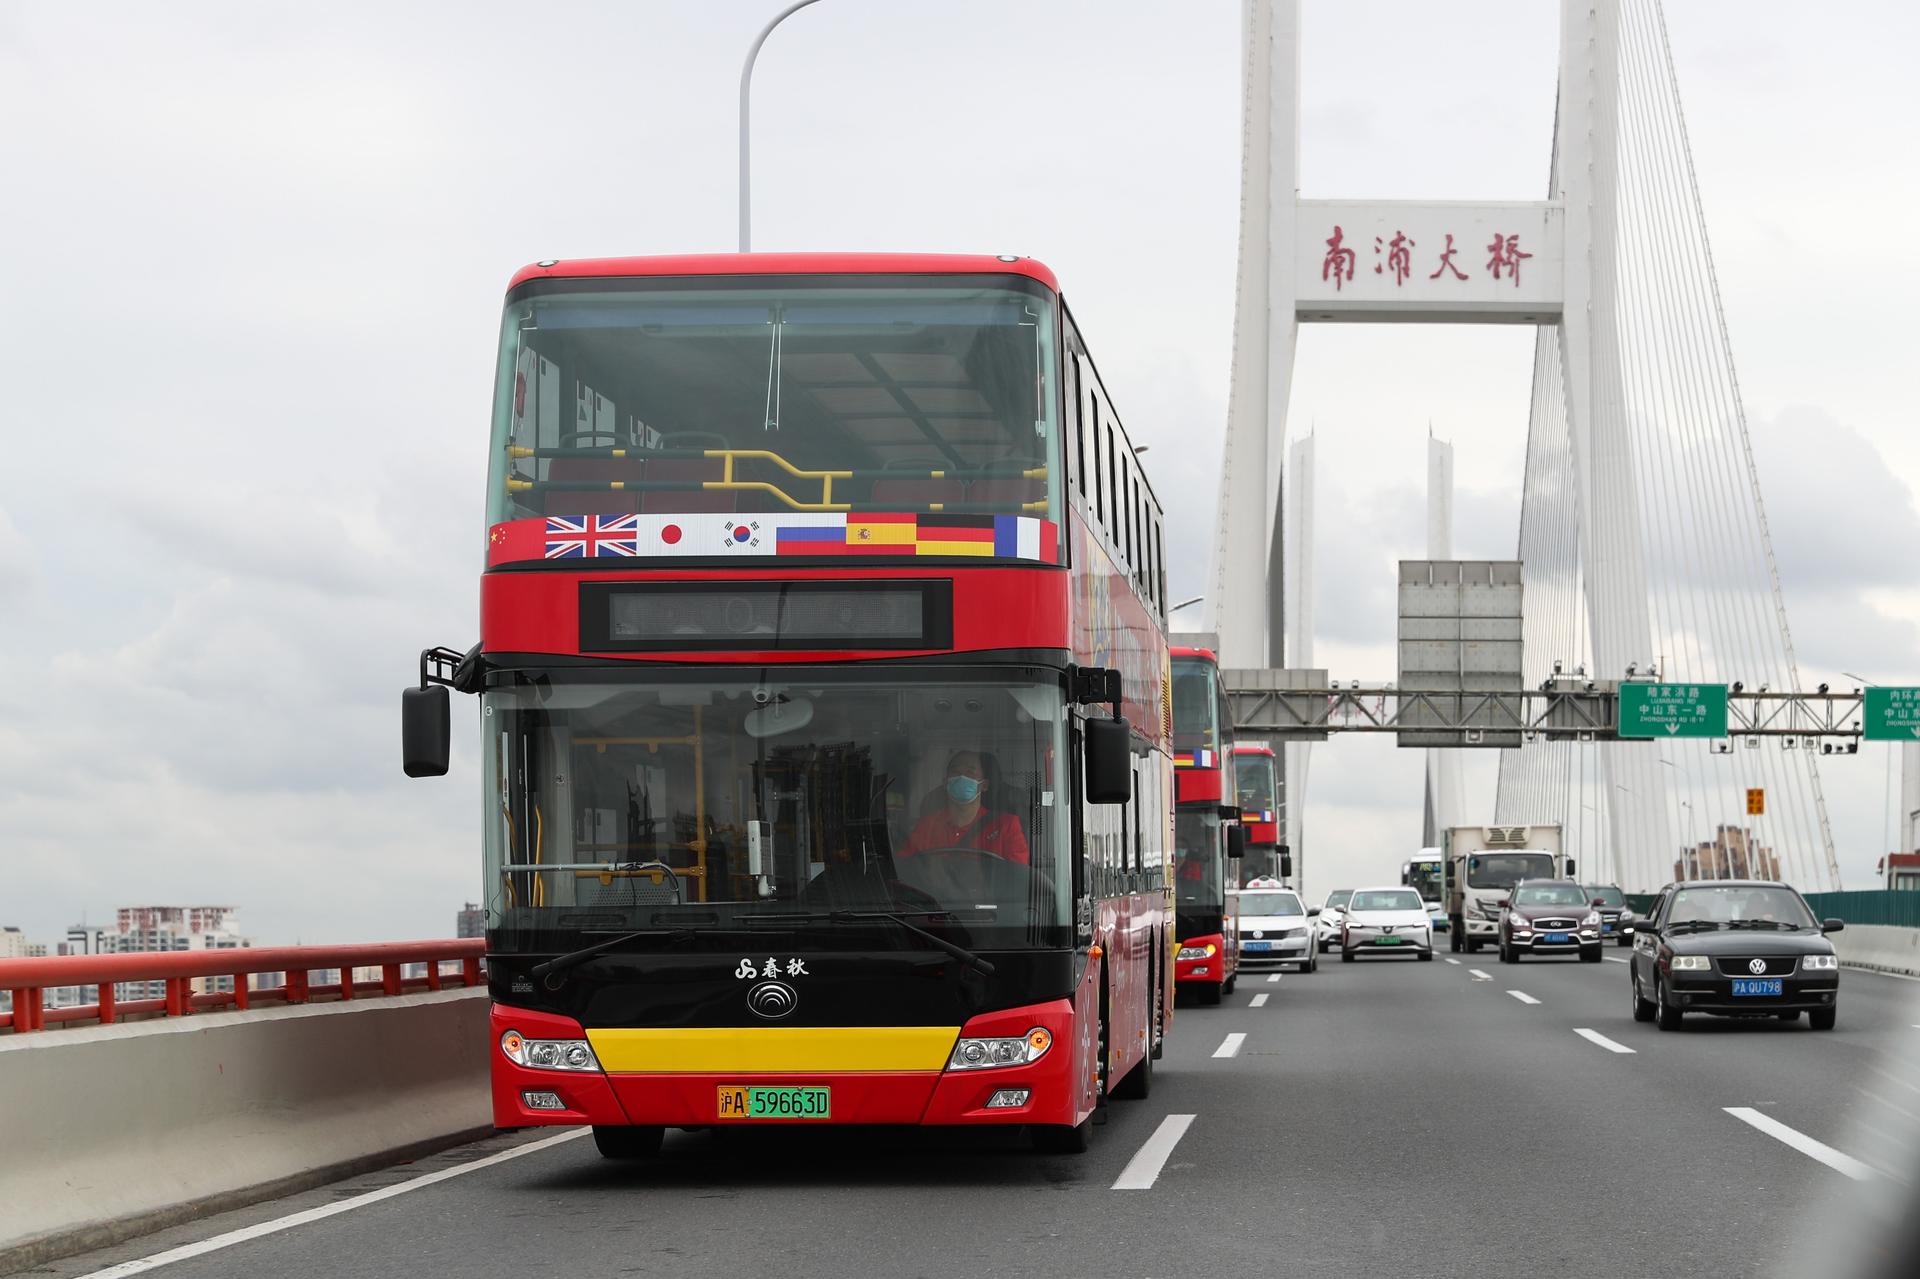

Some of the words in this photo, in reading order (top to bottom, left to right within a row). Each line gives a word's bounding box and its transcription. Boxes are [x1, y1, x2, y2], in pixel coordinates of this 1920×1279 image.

[1322, 225, 1533, 291] 南浦大桥
[1639, 704, 1706, 716] 中山东一路
[761, 957, 810, 979] 春秋
